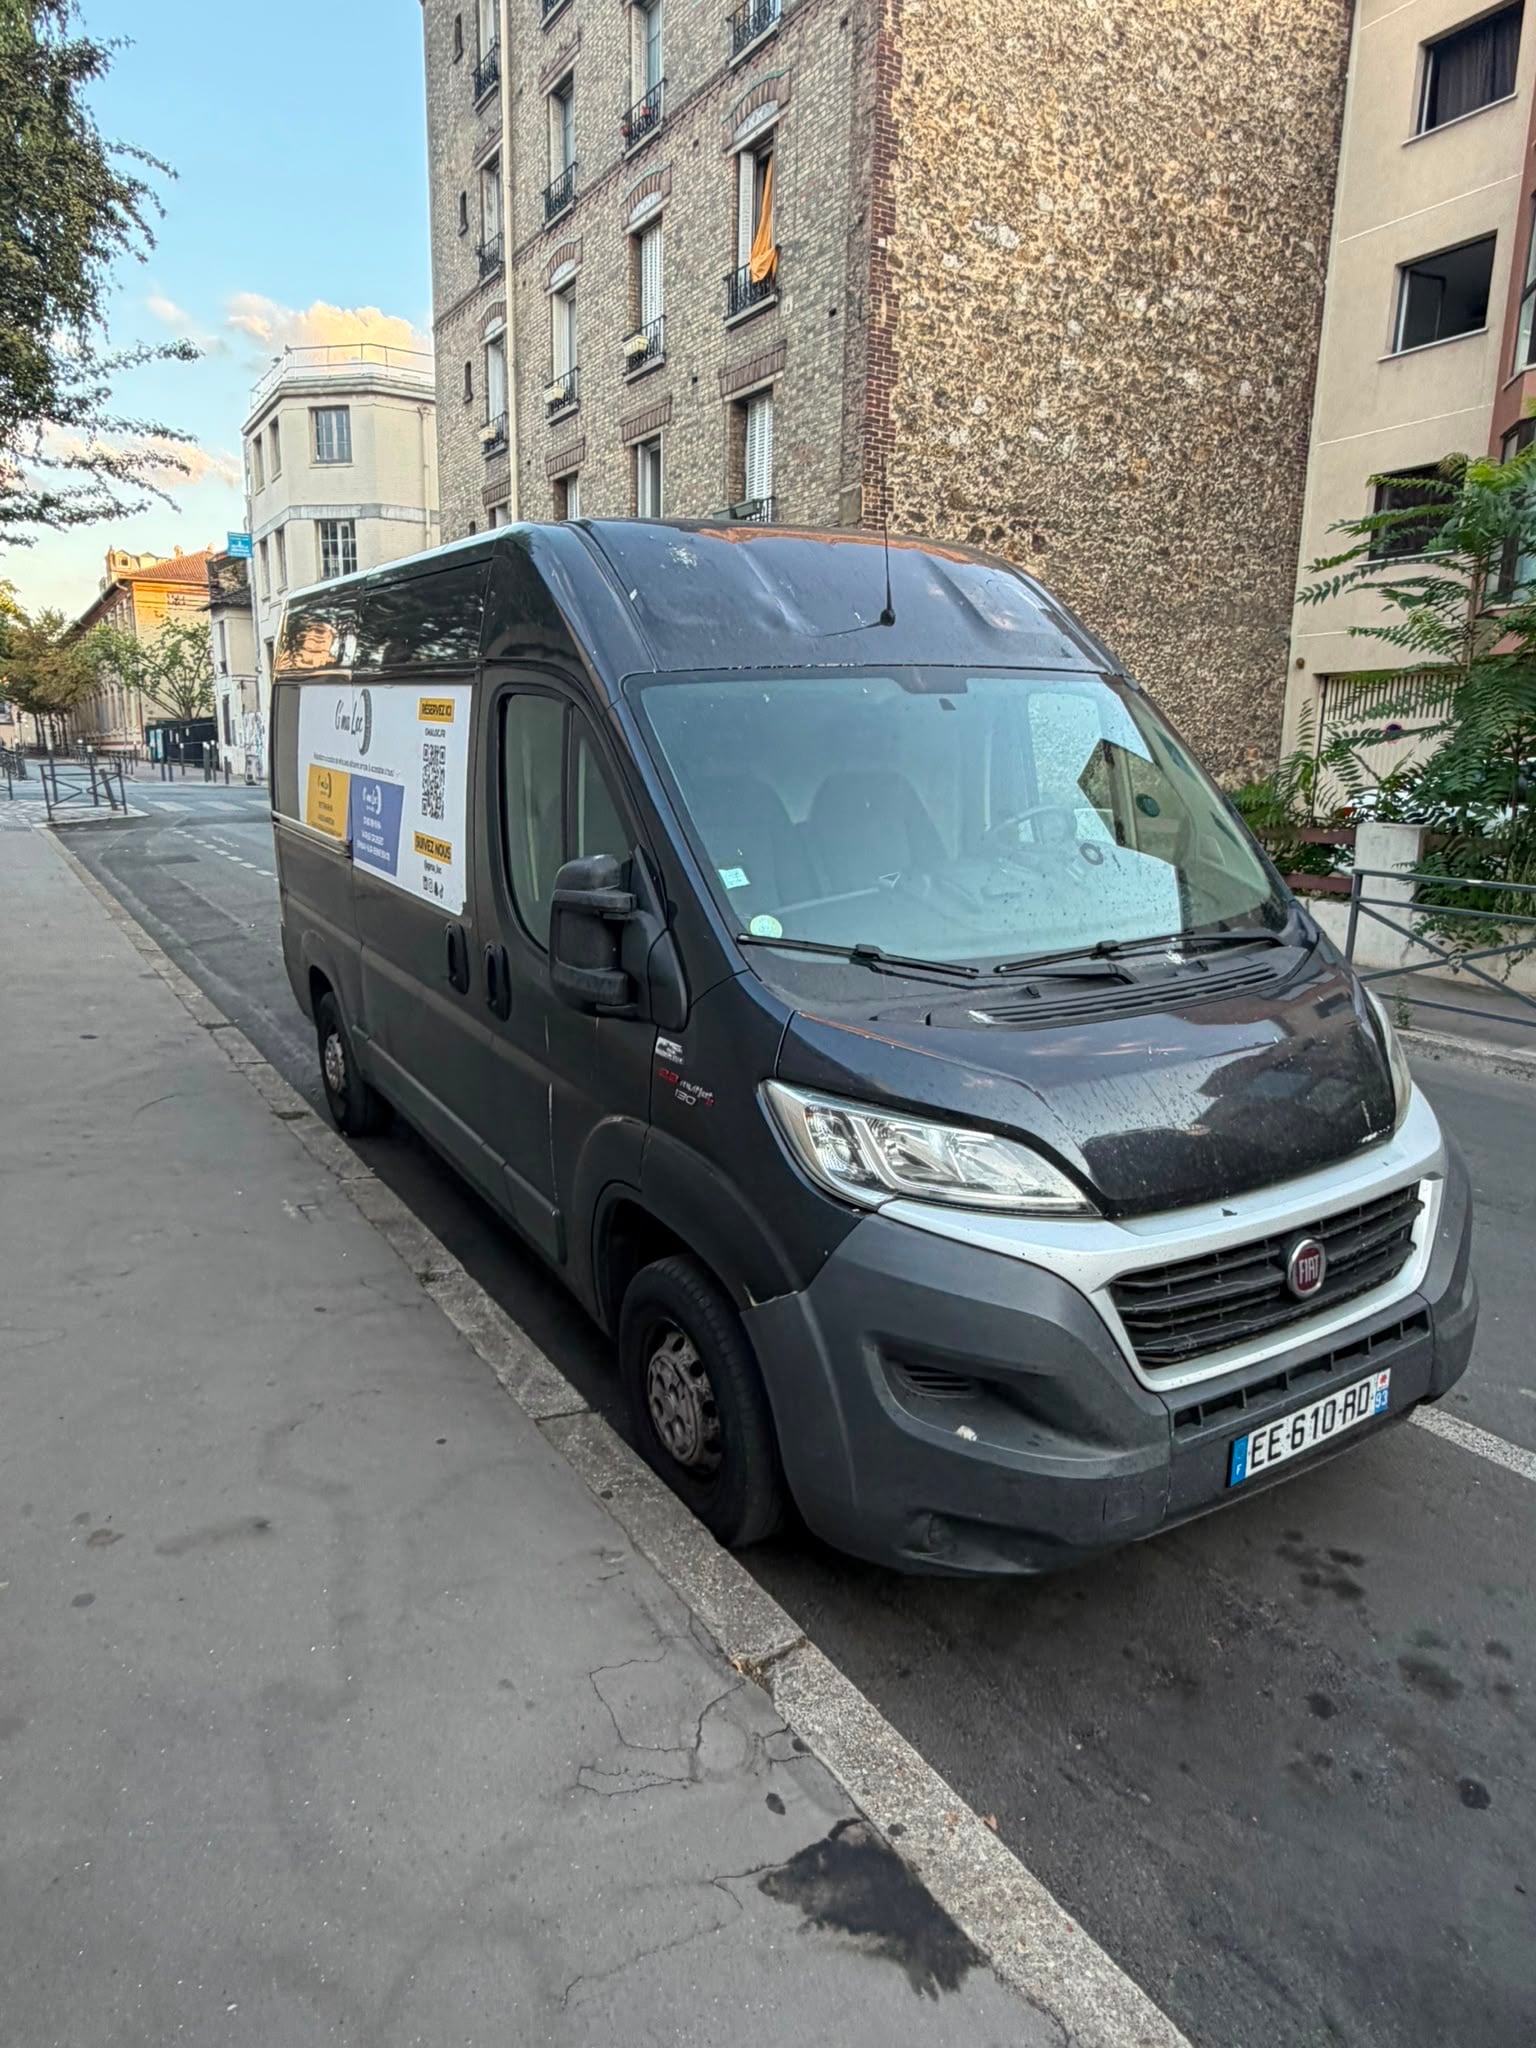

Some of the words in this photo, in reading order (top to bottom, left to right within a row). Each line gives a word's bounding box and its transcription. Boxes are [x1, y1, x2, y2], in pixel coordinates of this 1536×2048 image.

[435, 842, 452, 860] NOUS
[675, 1088, 697, 1105] 130
[1299, 1254, 1320, 1284] FIAT
[1375, 1390, 1389, 1409] 93
